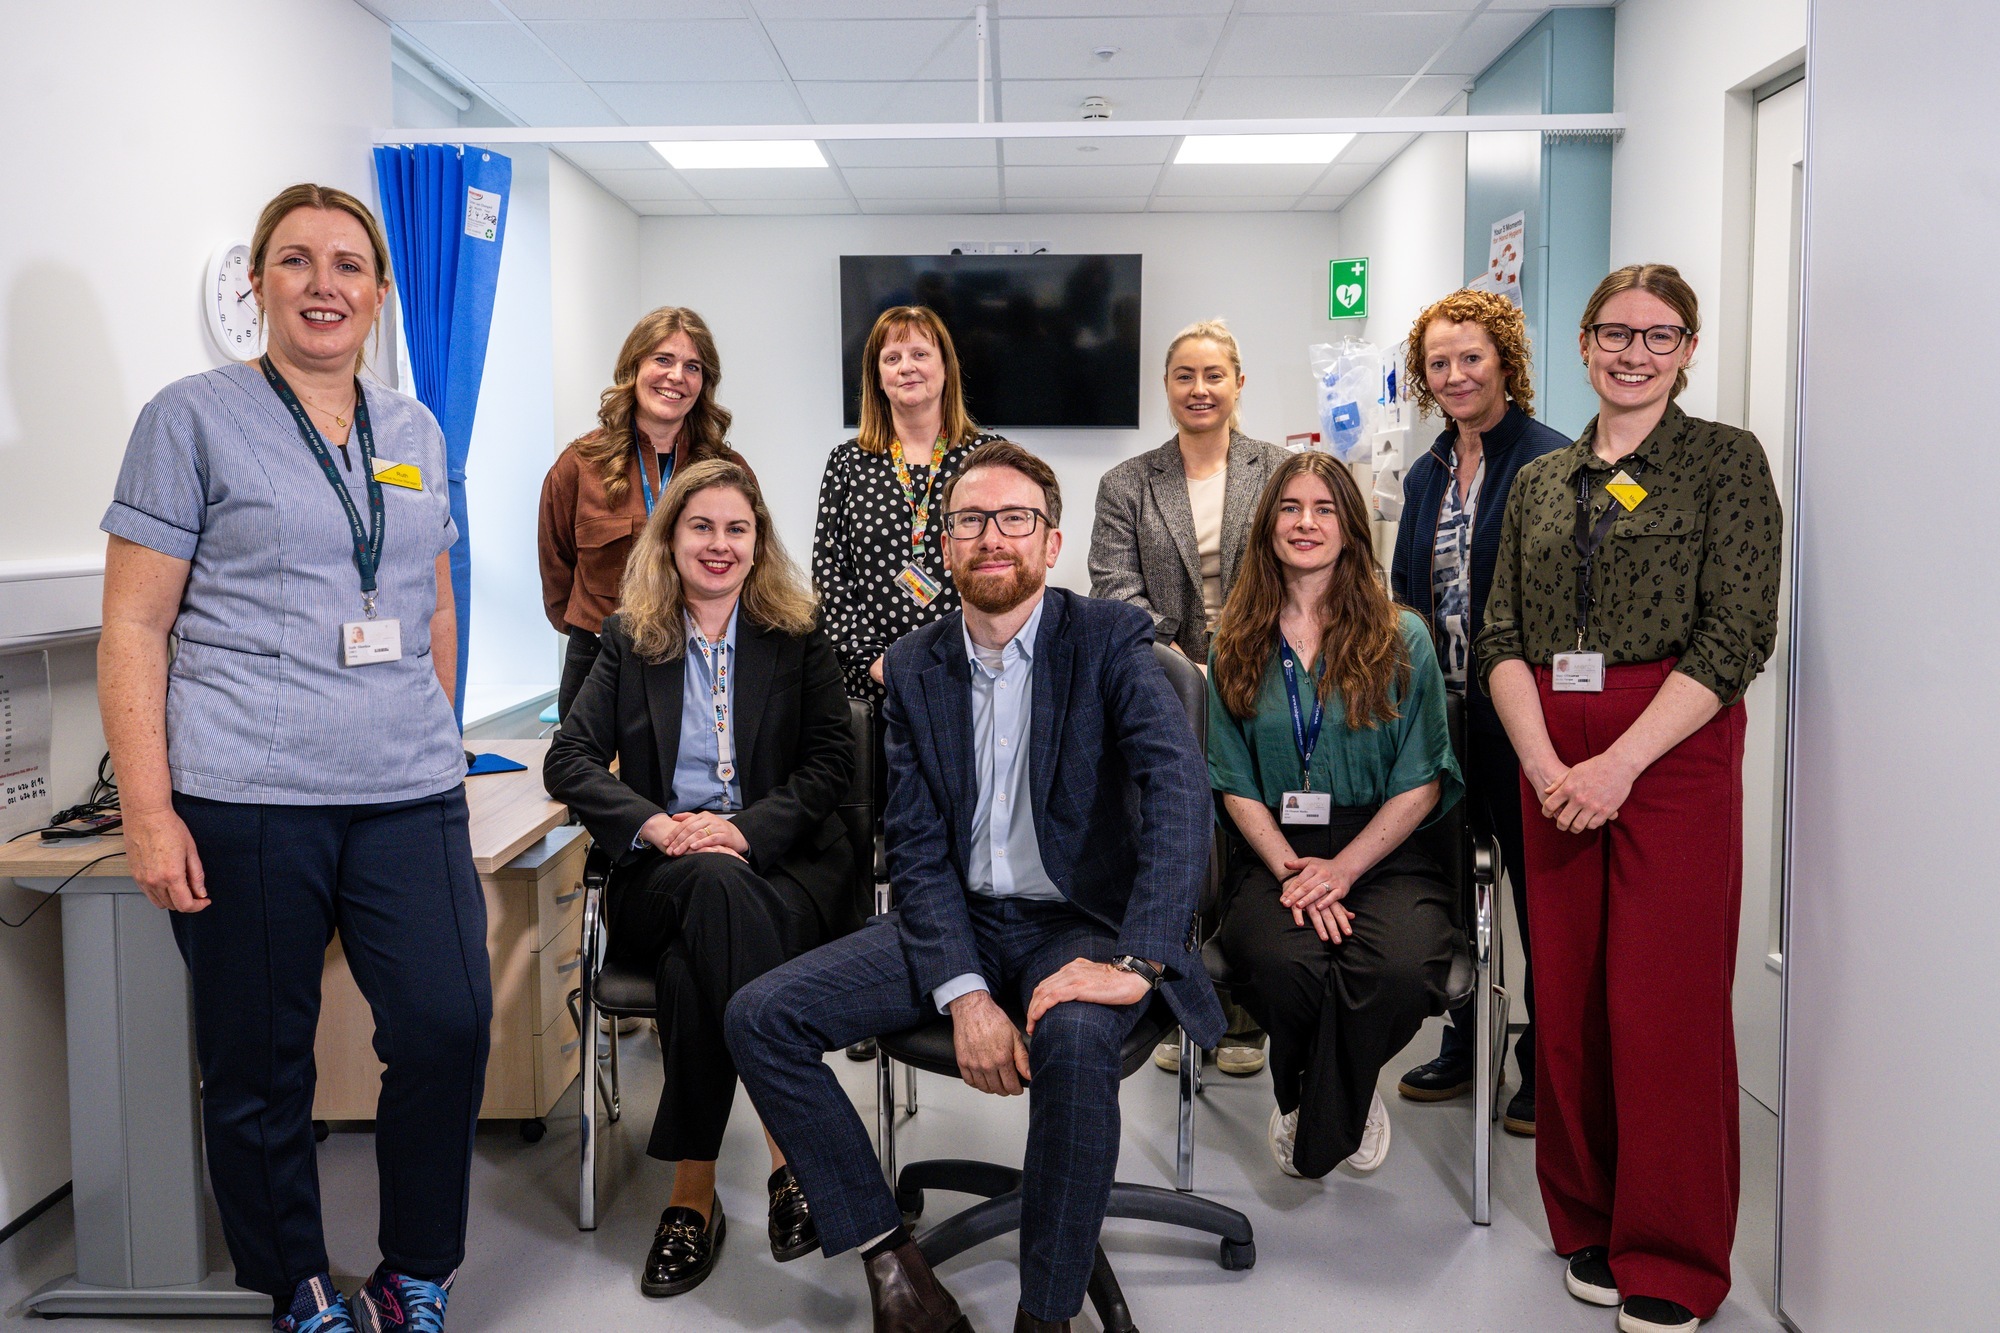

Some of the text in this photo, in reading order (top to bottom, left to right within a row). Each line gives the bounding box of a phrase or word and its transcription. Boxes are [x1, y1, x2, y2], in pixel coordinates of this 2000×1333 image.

[1506, 220, 1522, 230] Moments
[234, 256, 241, 264] 12
[225, 261, 231, 269] 11
[221, 313, 226, 322] 8
[227, 328, 233, 337] 7
[246, 330, 251, 338] 5
[236, 334, 242, 343] 6
[300, 416, 312, 433] vaccine
[312, 439, 320, 448] the
[316, 446, 324, 455] Get
[336, 483, 363, 538] Cork University Hospital
[371, 526, 381, 553] University
